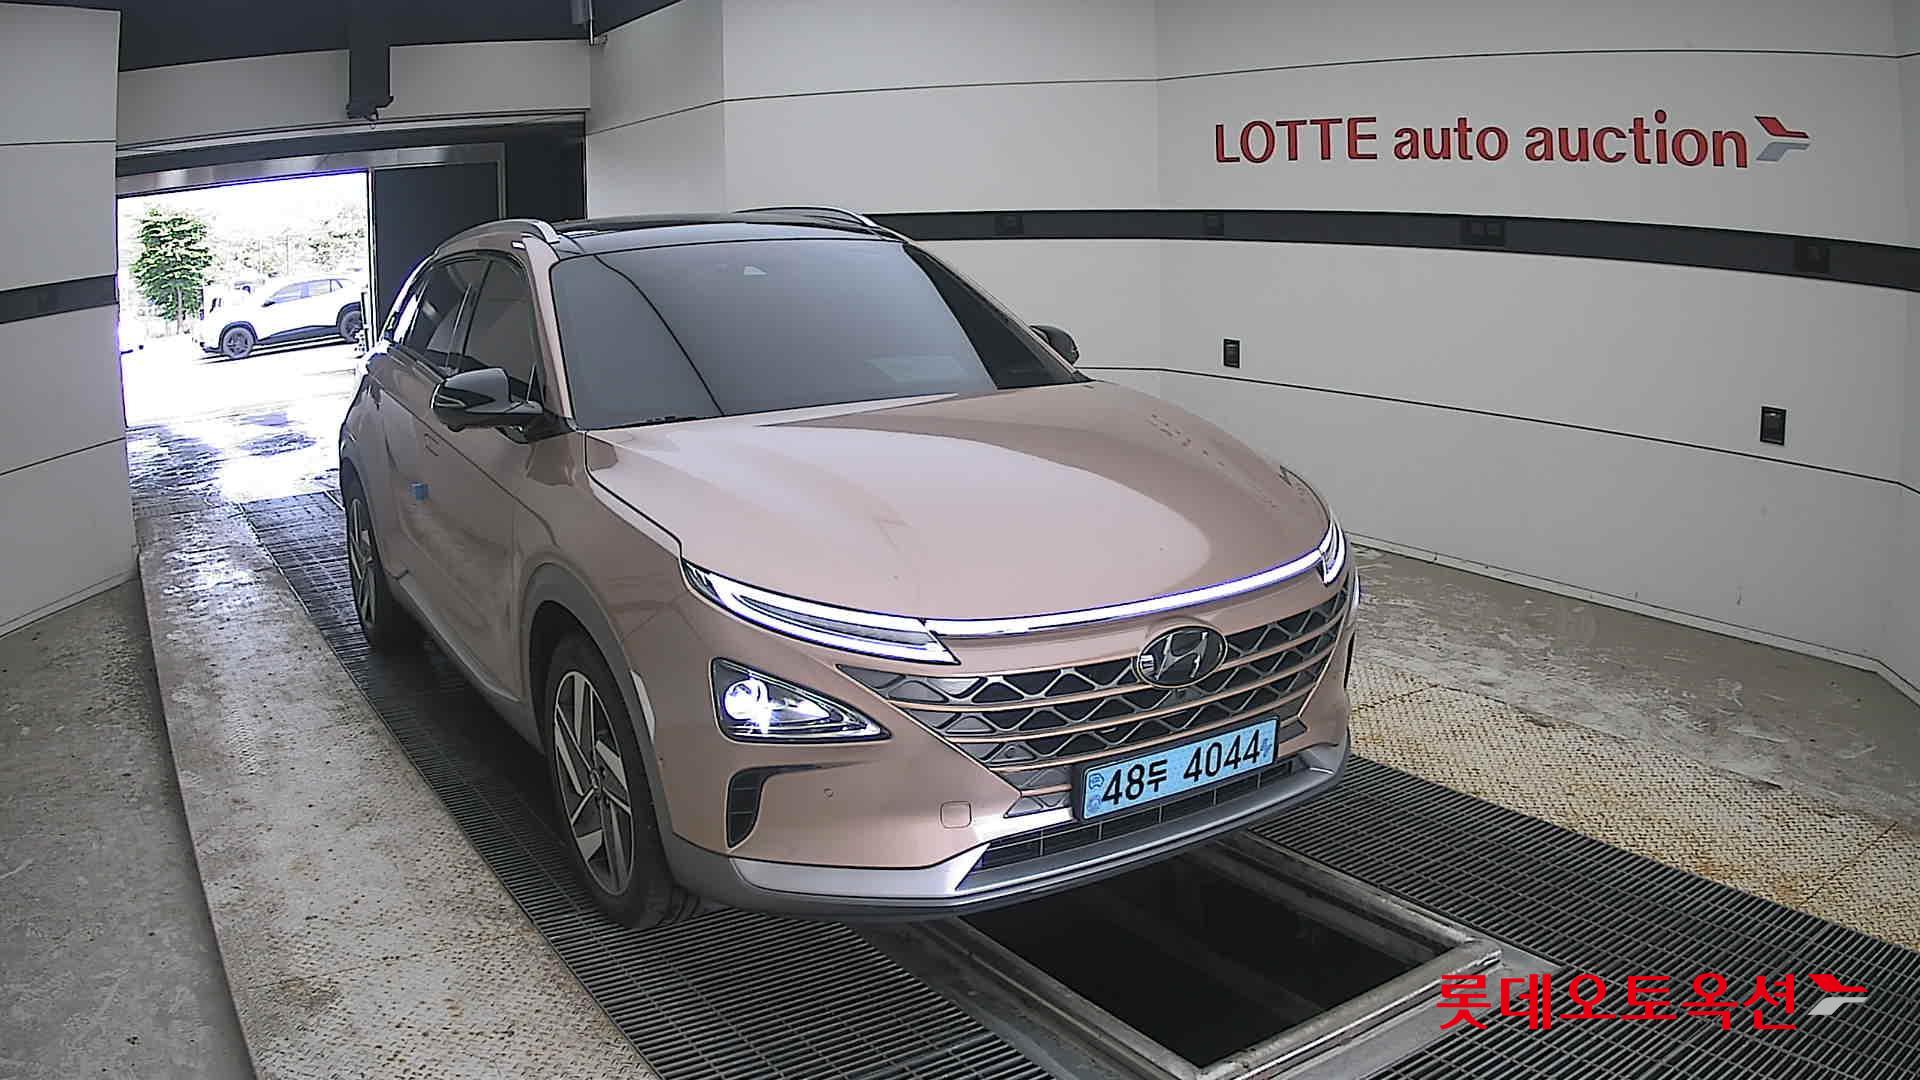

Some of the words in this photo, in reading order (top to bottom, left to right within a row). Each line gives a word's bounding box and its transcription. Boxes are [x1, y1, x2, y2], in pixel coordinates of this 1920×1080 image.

[1214, 115, 1378, 164] LOTTE
[1393, 116, 1509, 162] auto
[1525, 109, 1748, 169] auction
[1101, 759, 1168, 805] 48두
[1183, 728, 1261, 783] 4044
